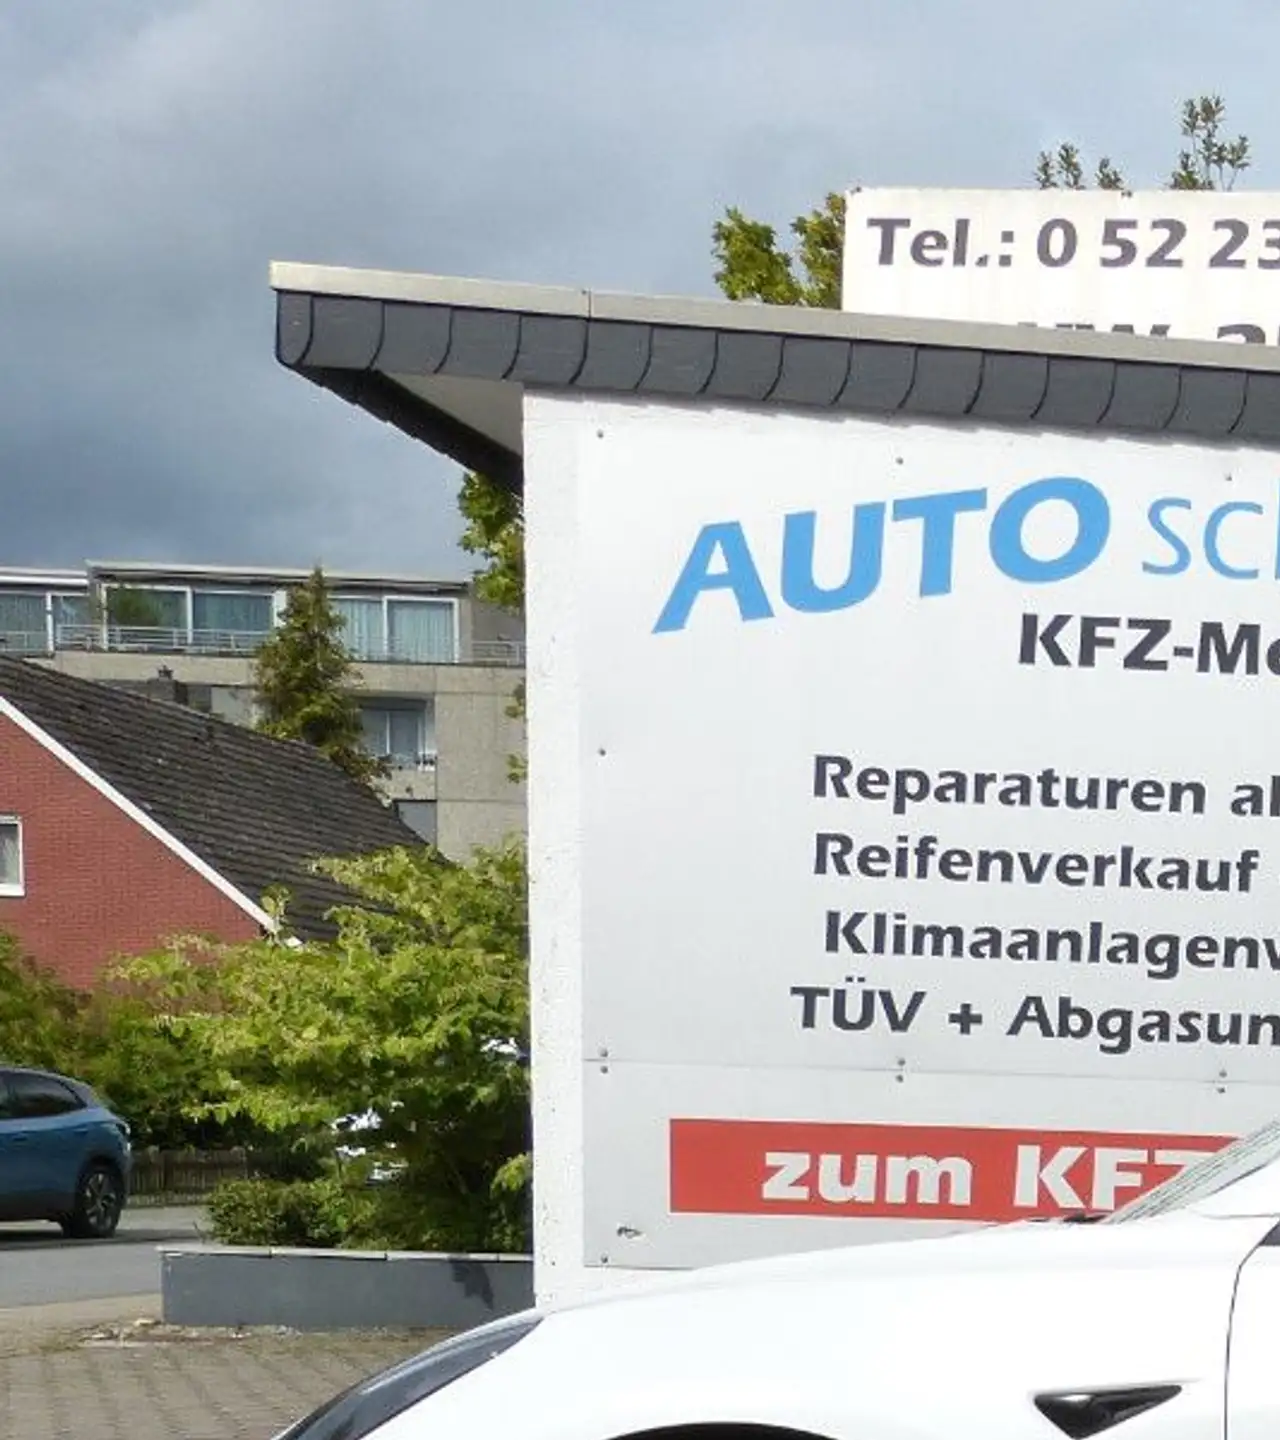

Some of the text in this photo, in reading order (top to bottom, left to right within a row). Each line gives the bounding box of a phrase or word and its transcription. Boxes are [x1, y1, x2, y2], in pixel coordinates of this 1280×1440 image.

[867, 217, 1015, 267] Tel.:
[812, 754, 1207, 816] Reparaturen
[812, 831, 1261, 894] Reifenverkauf
[789, 976, 928, 1034] TÜV
[947, 1002, 984, 1036] +
[761, 1150, 974, 1208] zum
